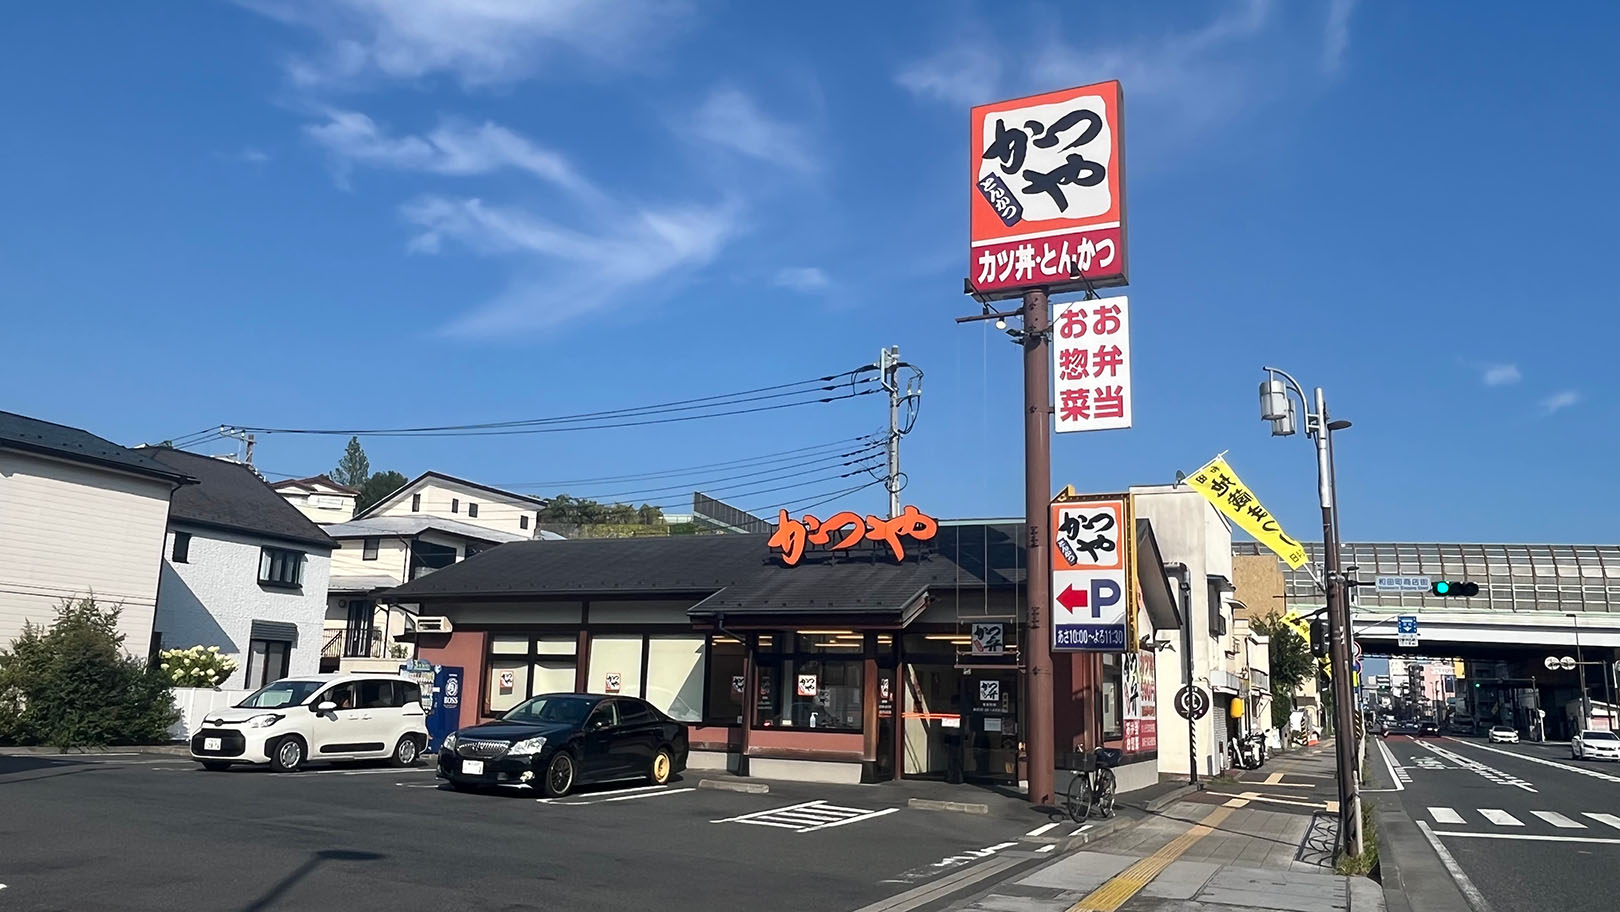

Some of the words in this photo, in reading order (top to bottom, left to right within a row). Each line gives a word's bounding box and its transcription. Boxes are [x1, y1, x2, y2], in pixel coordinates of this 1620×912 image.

[979, 176, 1018, 220] とんかつ
[1059, 308, 1090, 422] お惣菜
[1092, 303, 1124, 419] お弁当
[767, 505, 938, 566] かつや
[1090, 578, 1122, 619] P
[443, 696, 459, 704] BOSS
